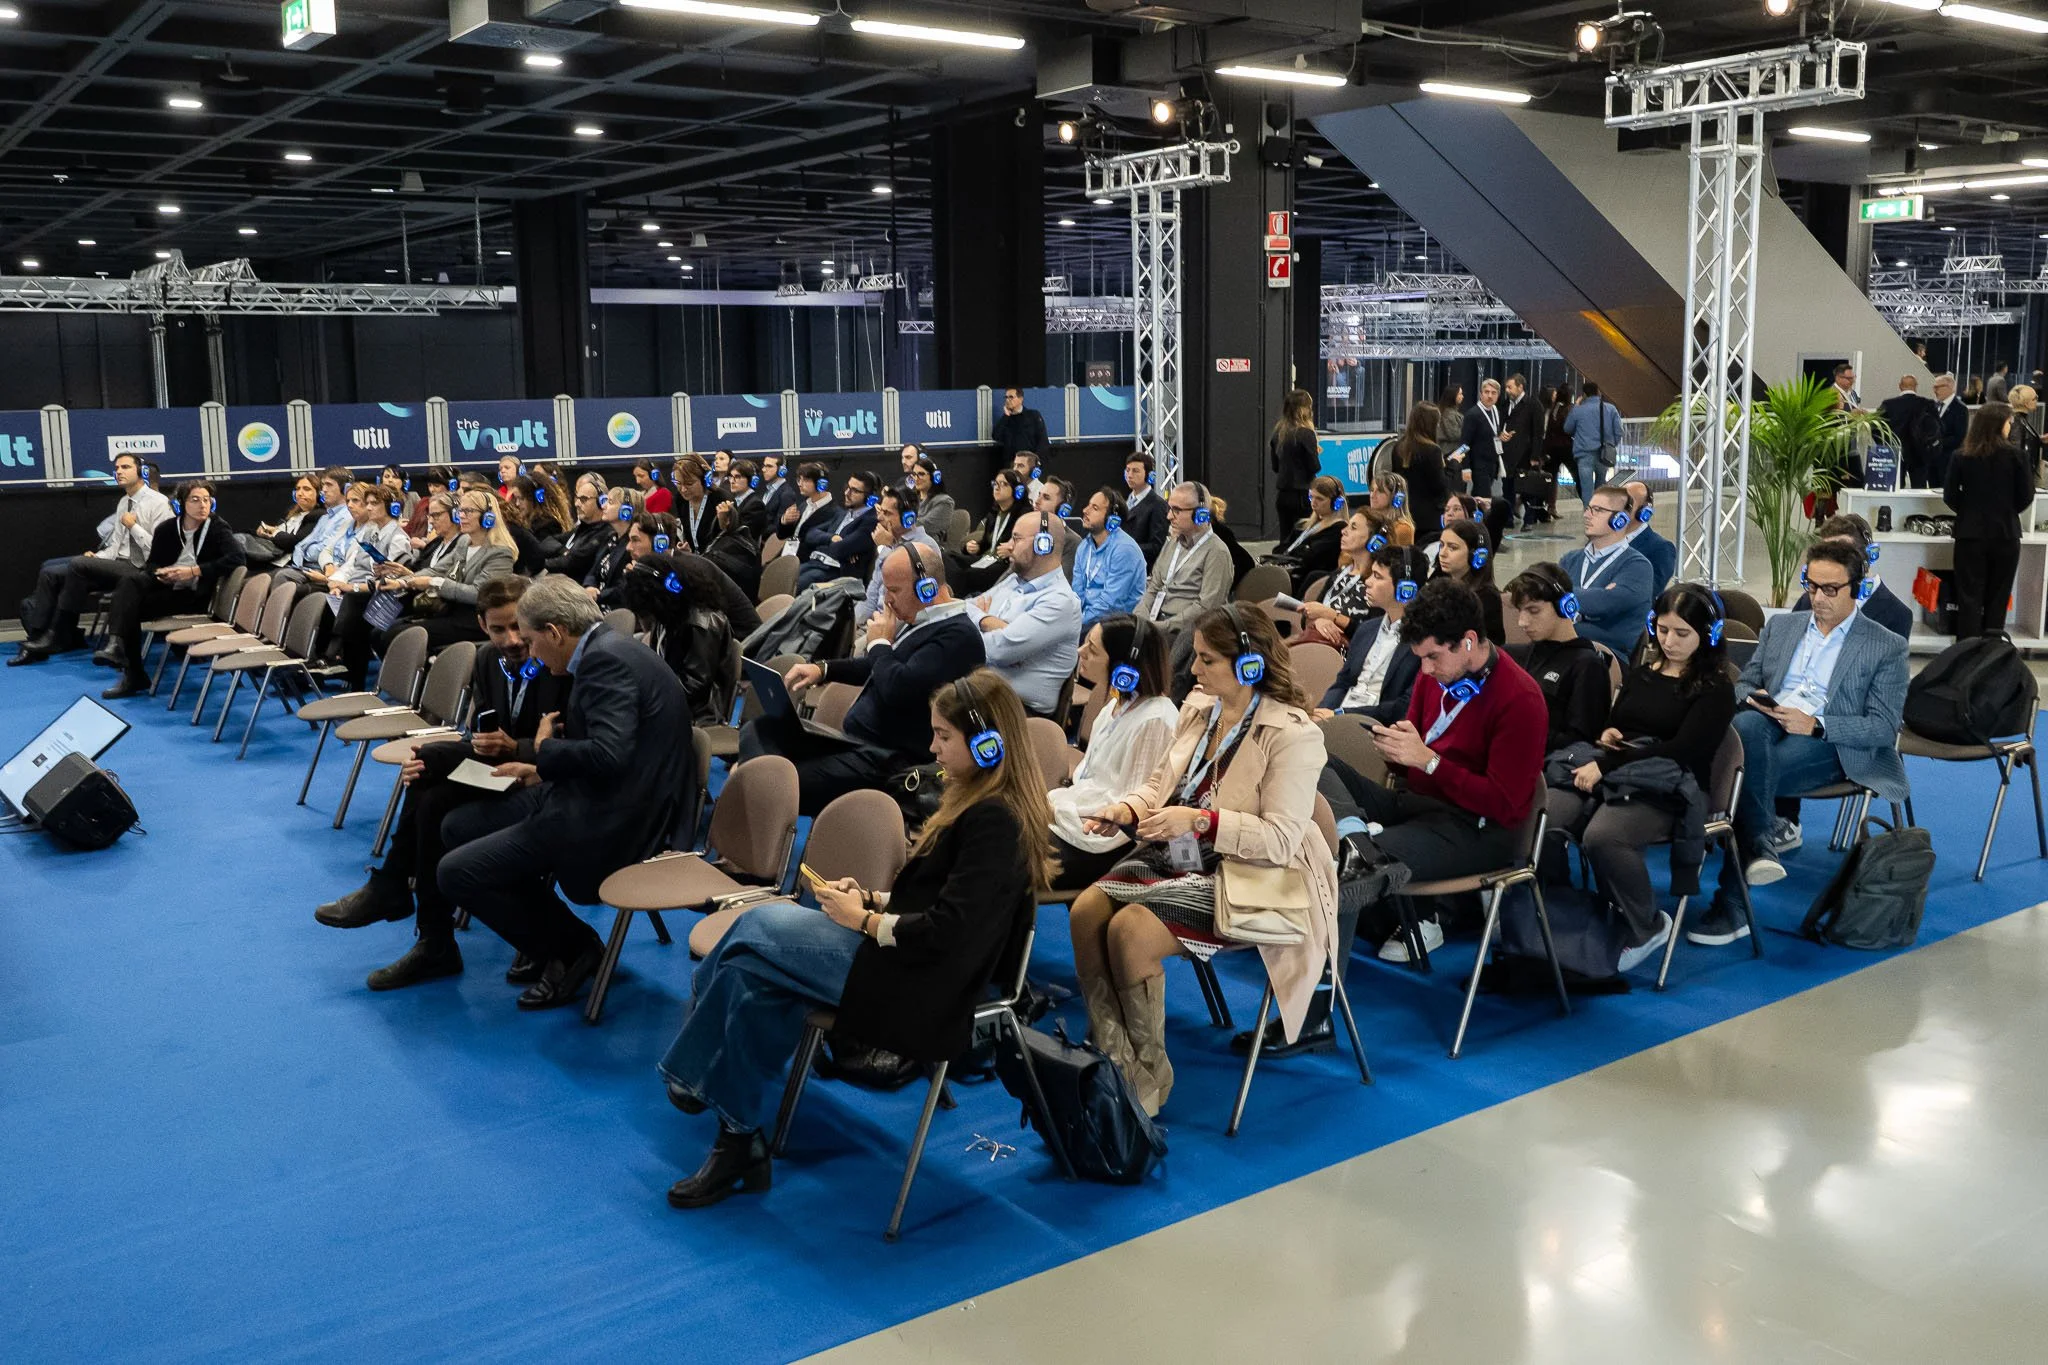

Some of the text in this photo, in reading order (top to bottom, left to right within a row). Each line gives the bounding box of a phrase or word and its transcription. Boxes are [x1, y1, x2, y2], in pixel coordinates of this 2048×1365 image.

[804, 408, 823, 418] the
[456, 418, 480, 430] the
[721, 420, 752, 430] CHORA
[804, 409, 878, 437] vault
[457, 419, 549, 450] vault
[115, 439, 159, 449] CHORA
